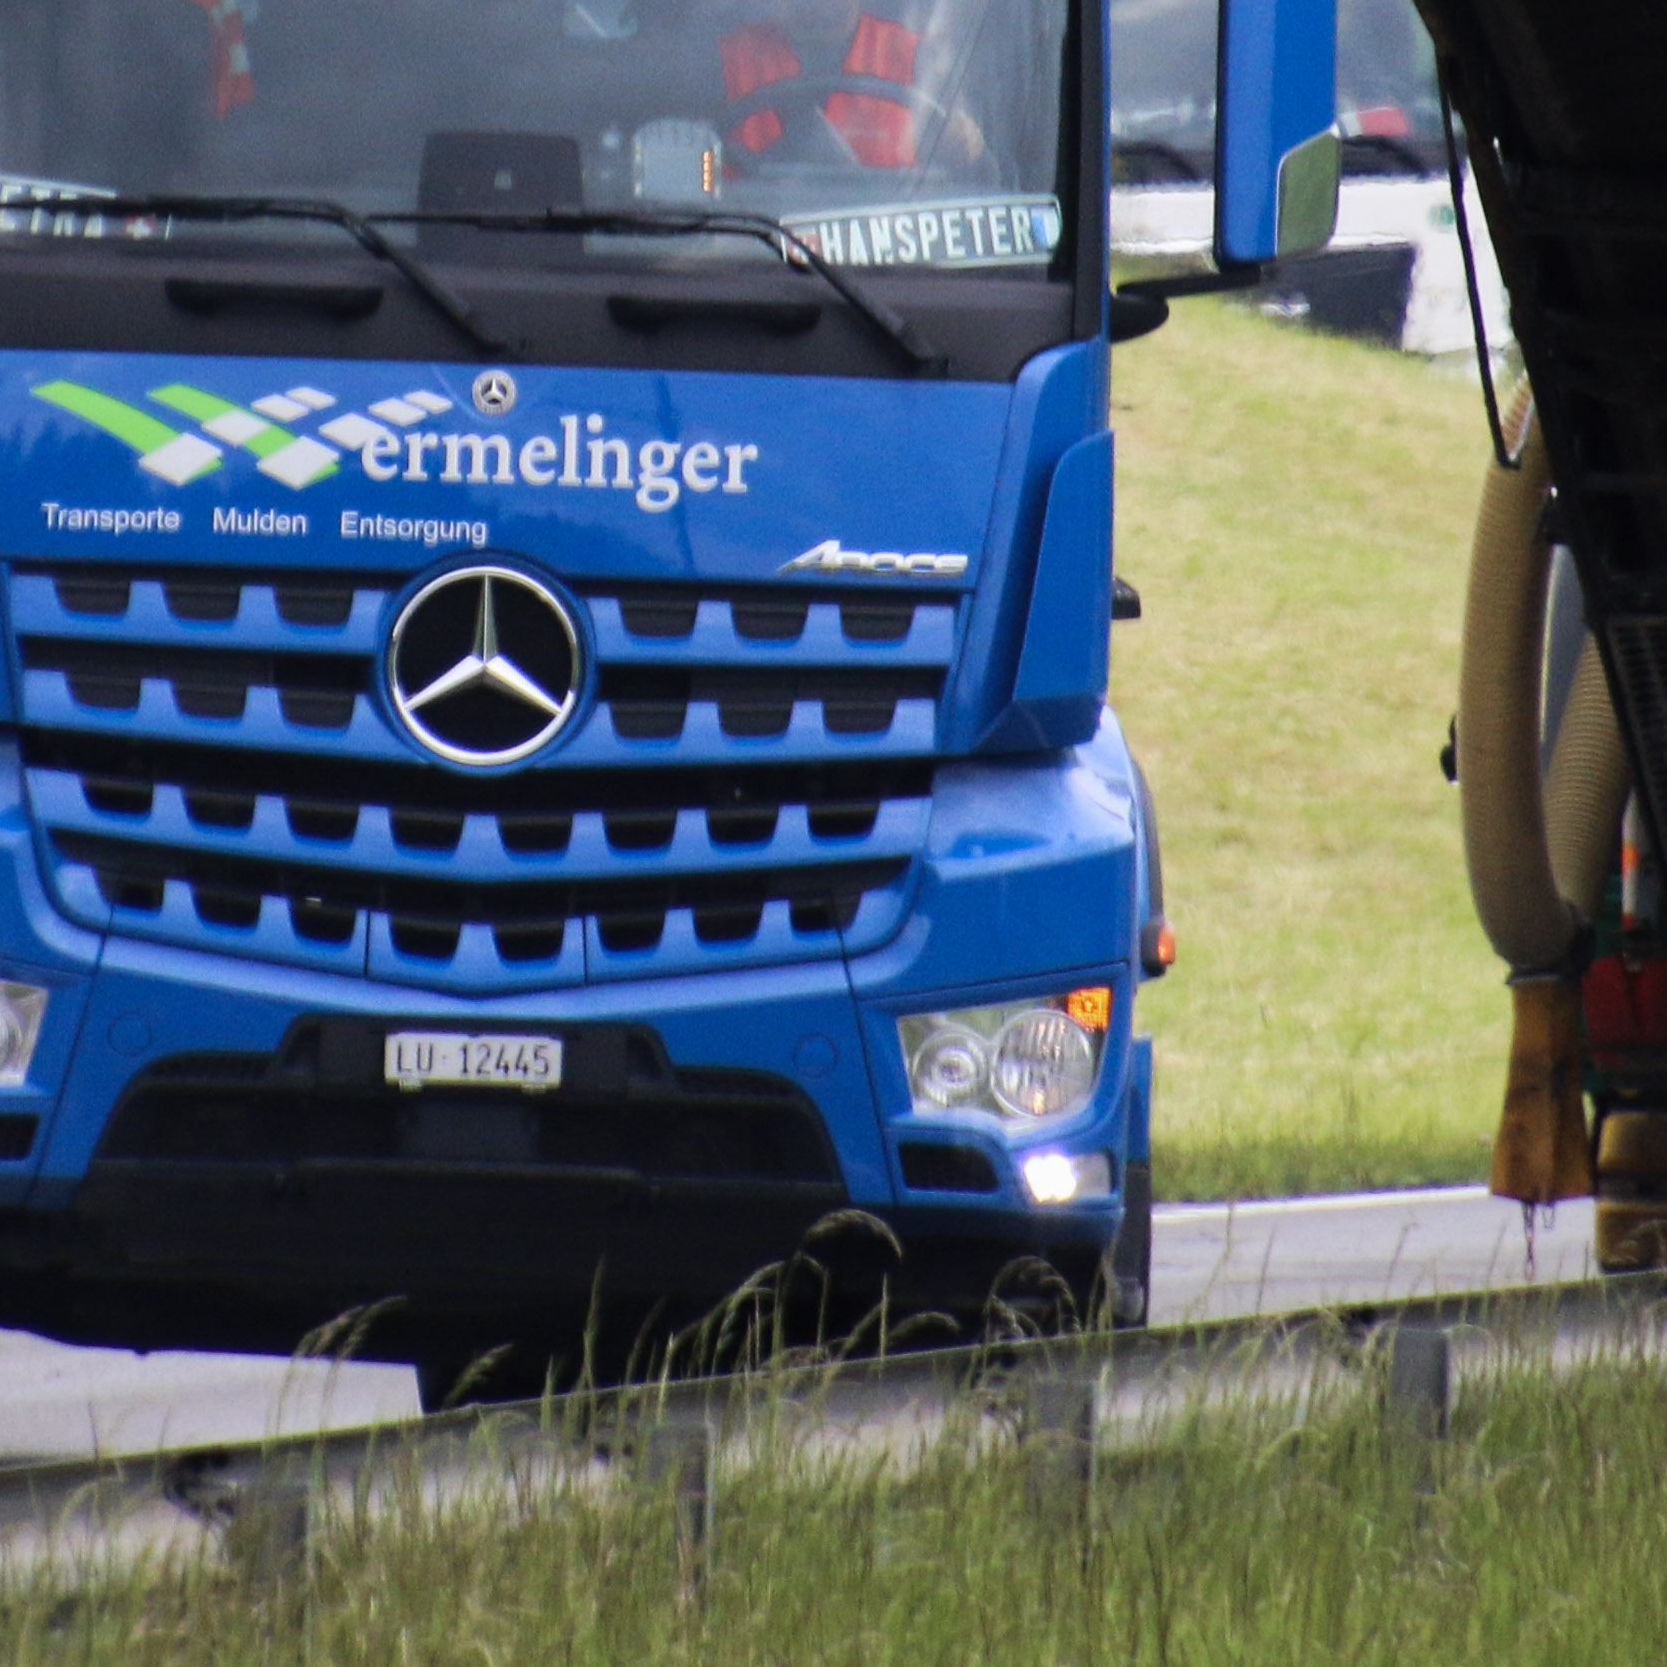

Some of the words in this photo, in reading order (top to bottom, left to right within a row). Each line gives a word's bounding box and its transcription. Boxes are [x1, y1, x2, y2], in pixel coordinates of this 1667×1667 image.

[819, 206, 1034, 266] HANSPETER
[40, 502, 181, 535] Transporte
[212, 506, 307, 535] Mulden
[339, 509, 488, 546] Entsorgung
[458, 1042, 551, 1076] 12445
